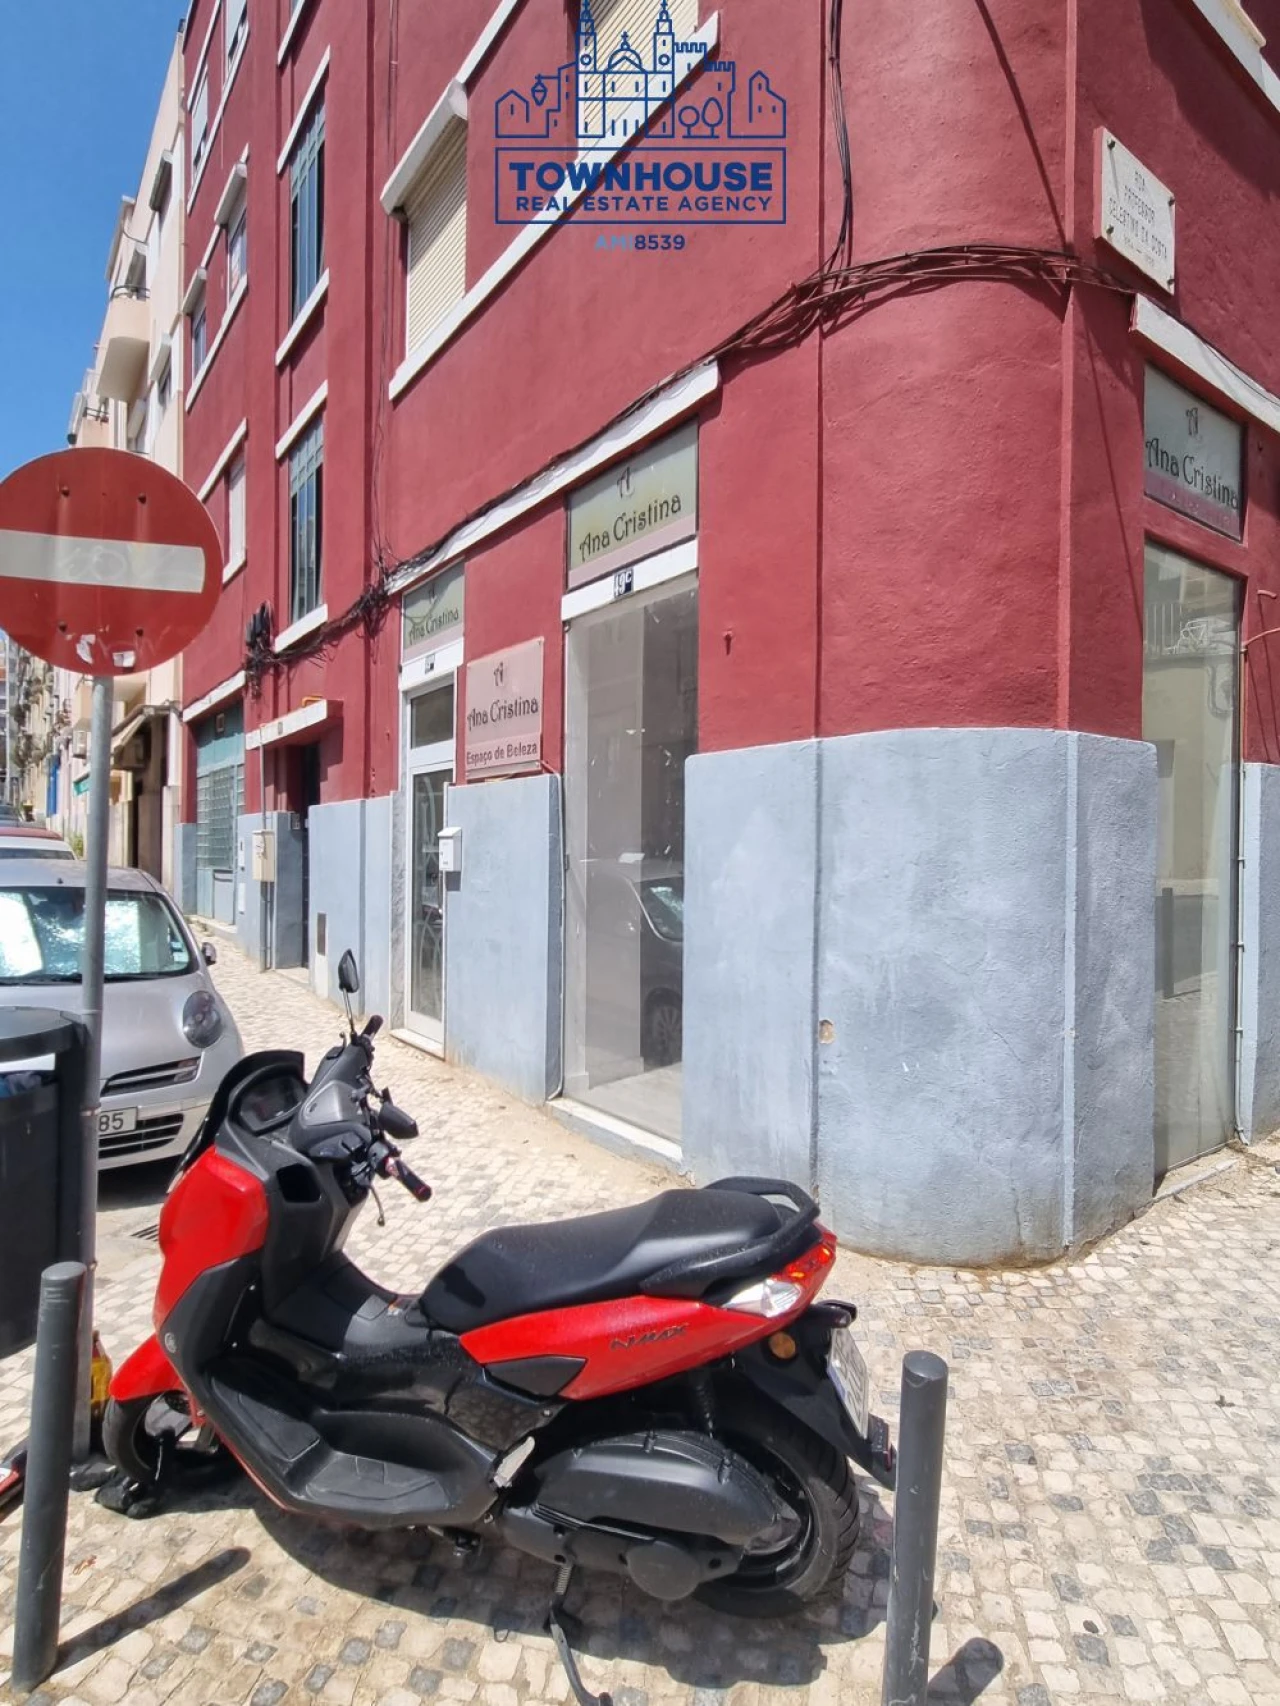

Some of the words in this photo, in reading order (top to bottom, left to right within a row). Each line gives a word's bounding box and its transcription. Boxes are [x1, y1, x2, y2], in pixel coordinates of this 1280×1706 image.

[1145, 437, 1180, 477] Ana
[1182, 454, 1240, 511] Cristina
[579, 531, 610, 563] Ana
[613, 494, 682, 542] Cristina
[466, 707, 489, 732] Ana
[489, 695, 539, 723] Cristina
[466, 750, 492, 767] Espaço
[494, 746, 505, 761] de
[506, 741, 538, 759] Beleza
